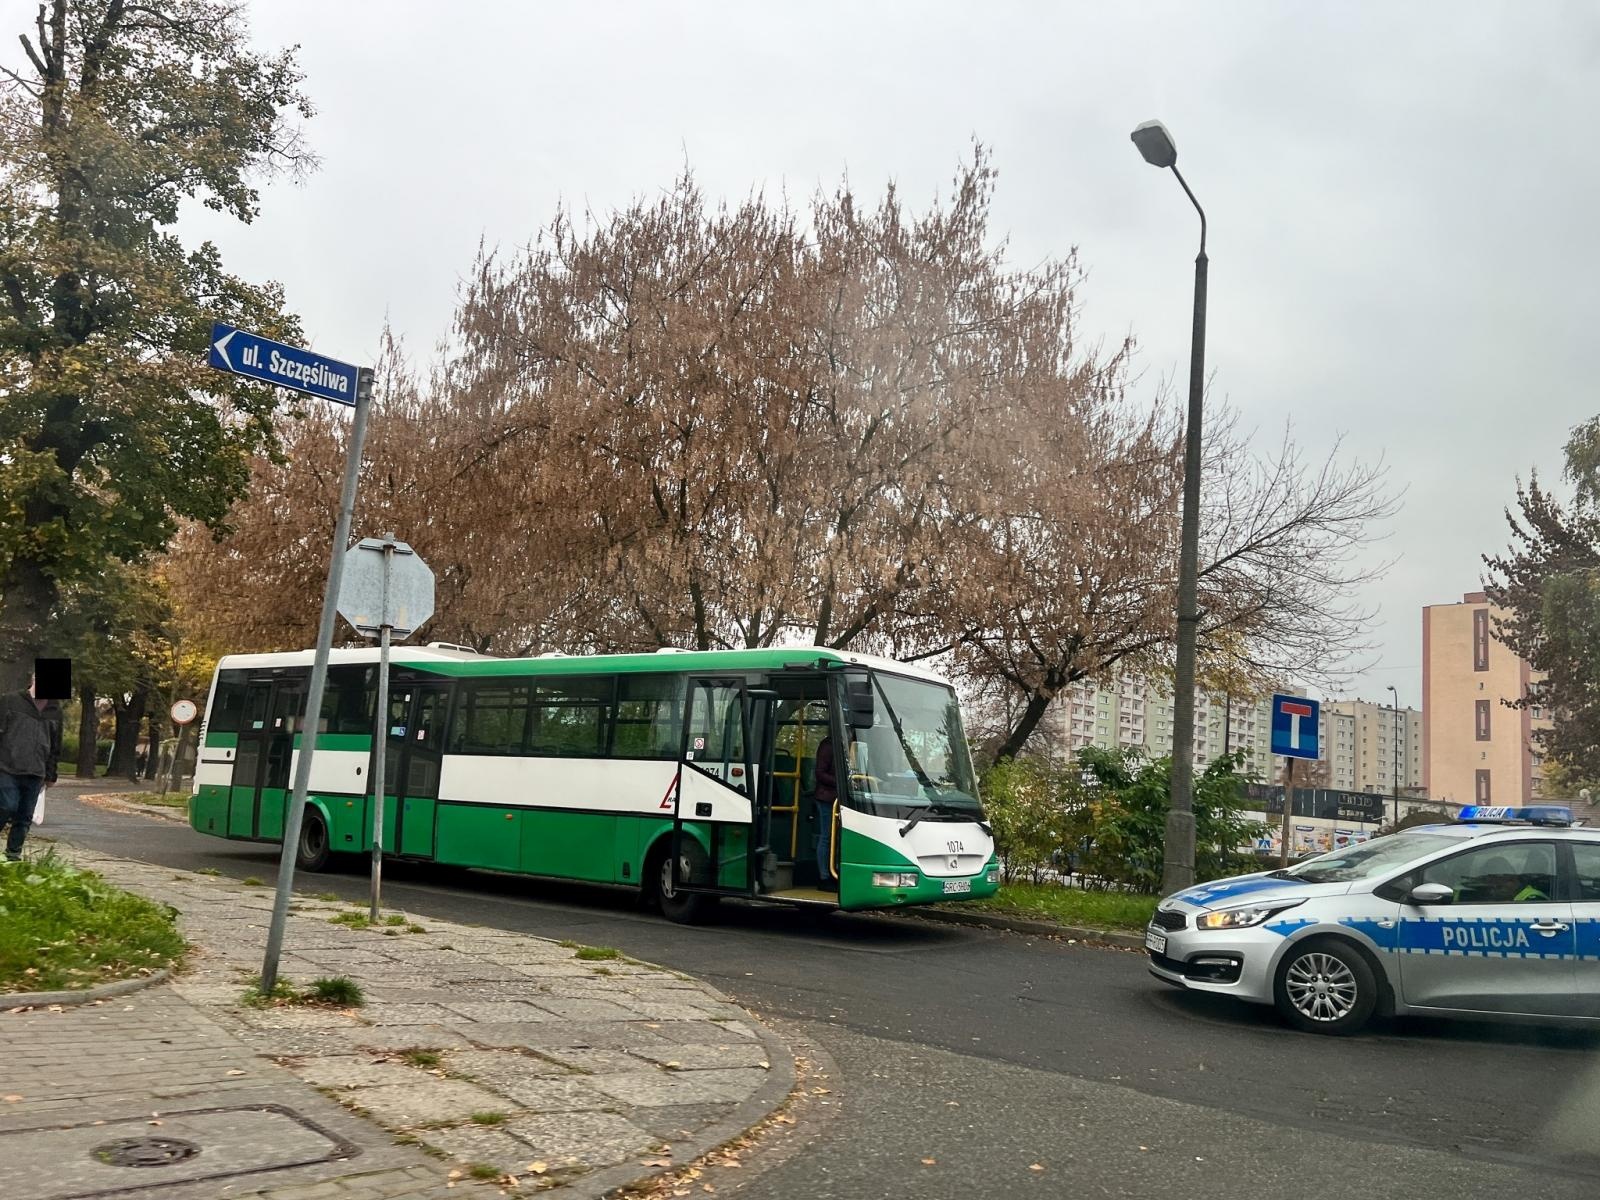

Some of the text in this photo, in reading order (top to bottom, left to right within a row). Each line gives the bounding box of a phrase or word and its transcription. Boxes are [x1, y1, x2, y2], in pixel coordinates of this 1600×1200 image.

[243, 345, 348, 392] ul. Szczęśliwa
[1477, 808, 1505, 818] POLICJA
[947, 841, 964, 853] 1074
[1442, 927, 1530, 948] POLICJA
